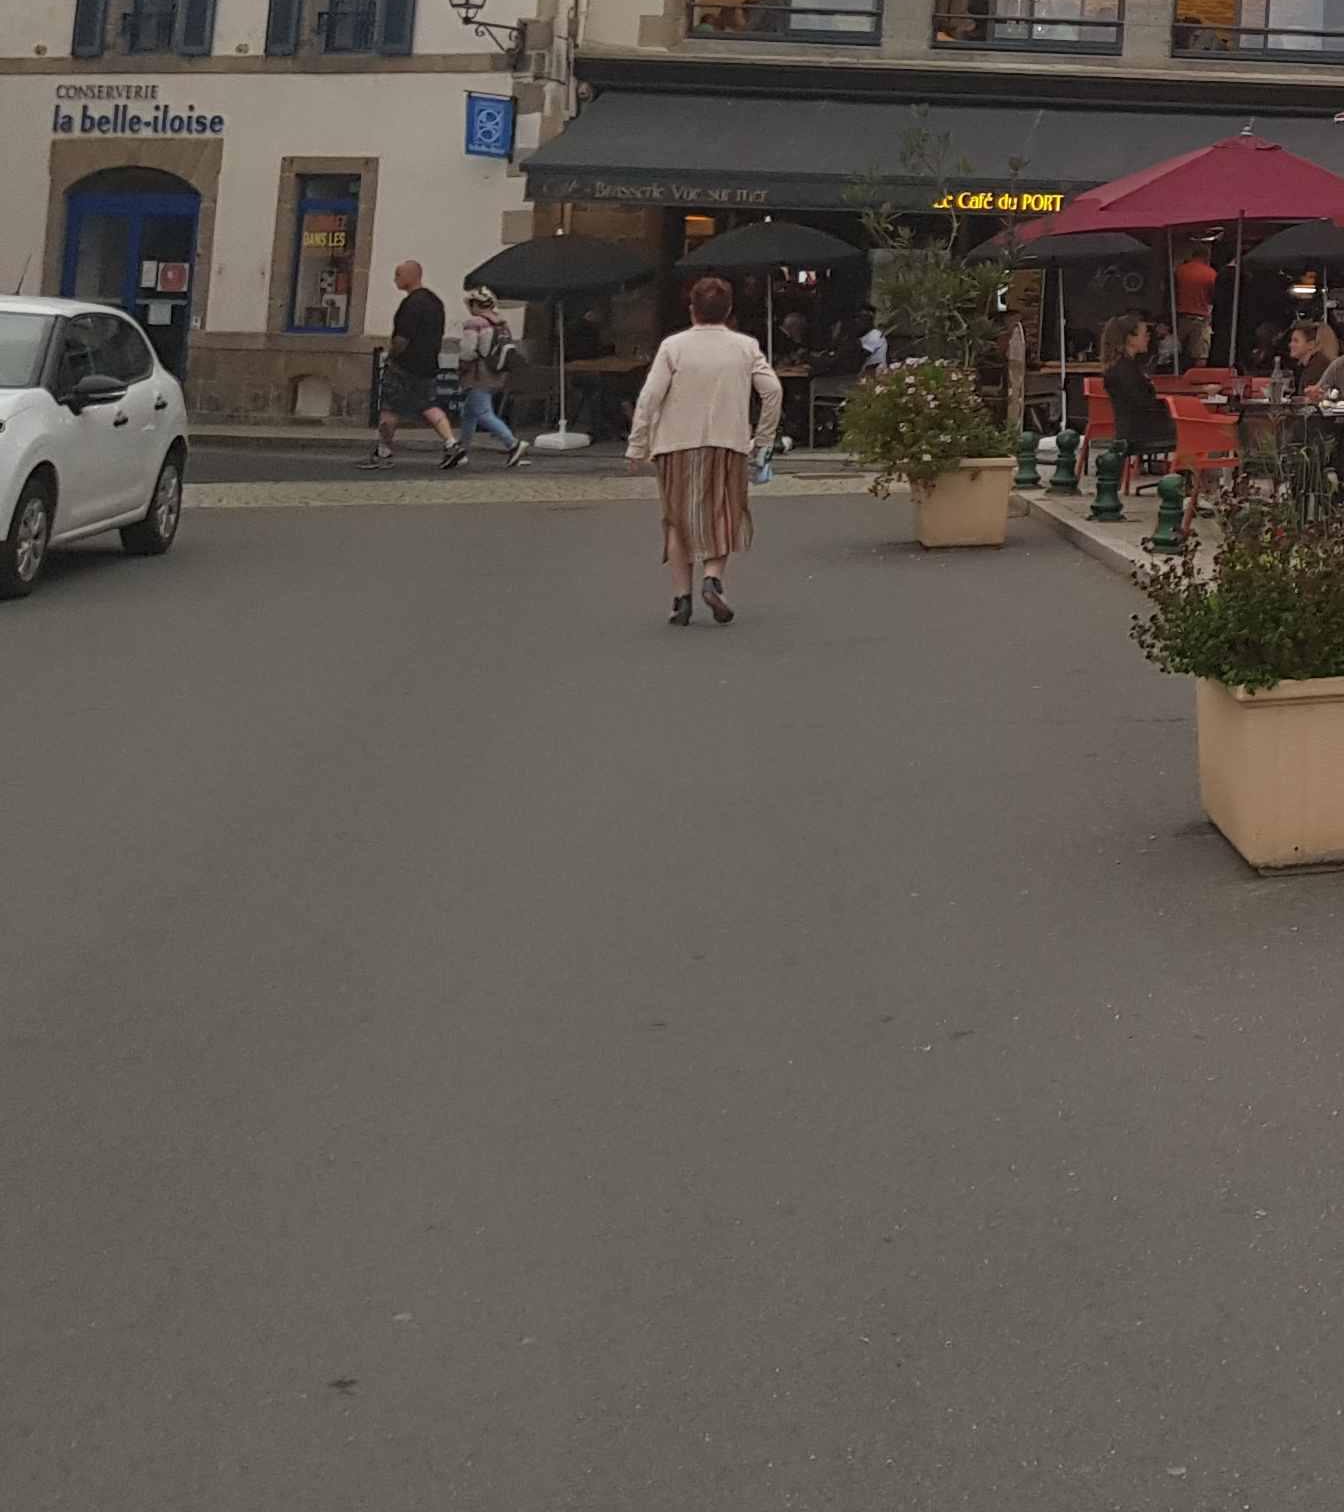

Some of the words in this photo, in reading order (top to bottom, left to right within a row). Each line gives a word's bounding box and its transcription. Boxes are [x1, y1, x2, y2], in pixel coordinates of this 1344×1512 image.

[55, 84, 159, 100] CONSERVERIE
[53, 104, 74, 133] la
[80, 104, 224, 134] belle-iloise
[672, 185, 700, 201] Vue
[707, 188, 729, 202] sur
[736, 189, 769, 204] mer
[957, 191, 994, 210] Café
[998, 192, 1018, 210] du
[1021, 193, 1066, 212] PORT
[328, 231, 347, 247] LES
